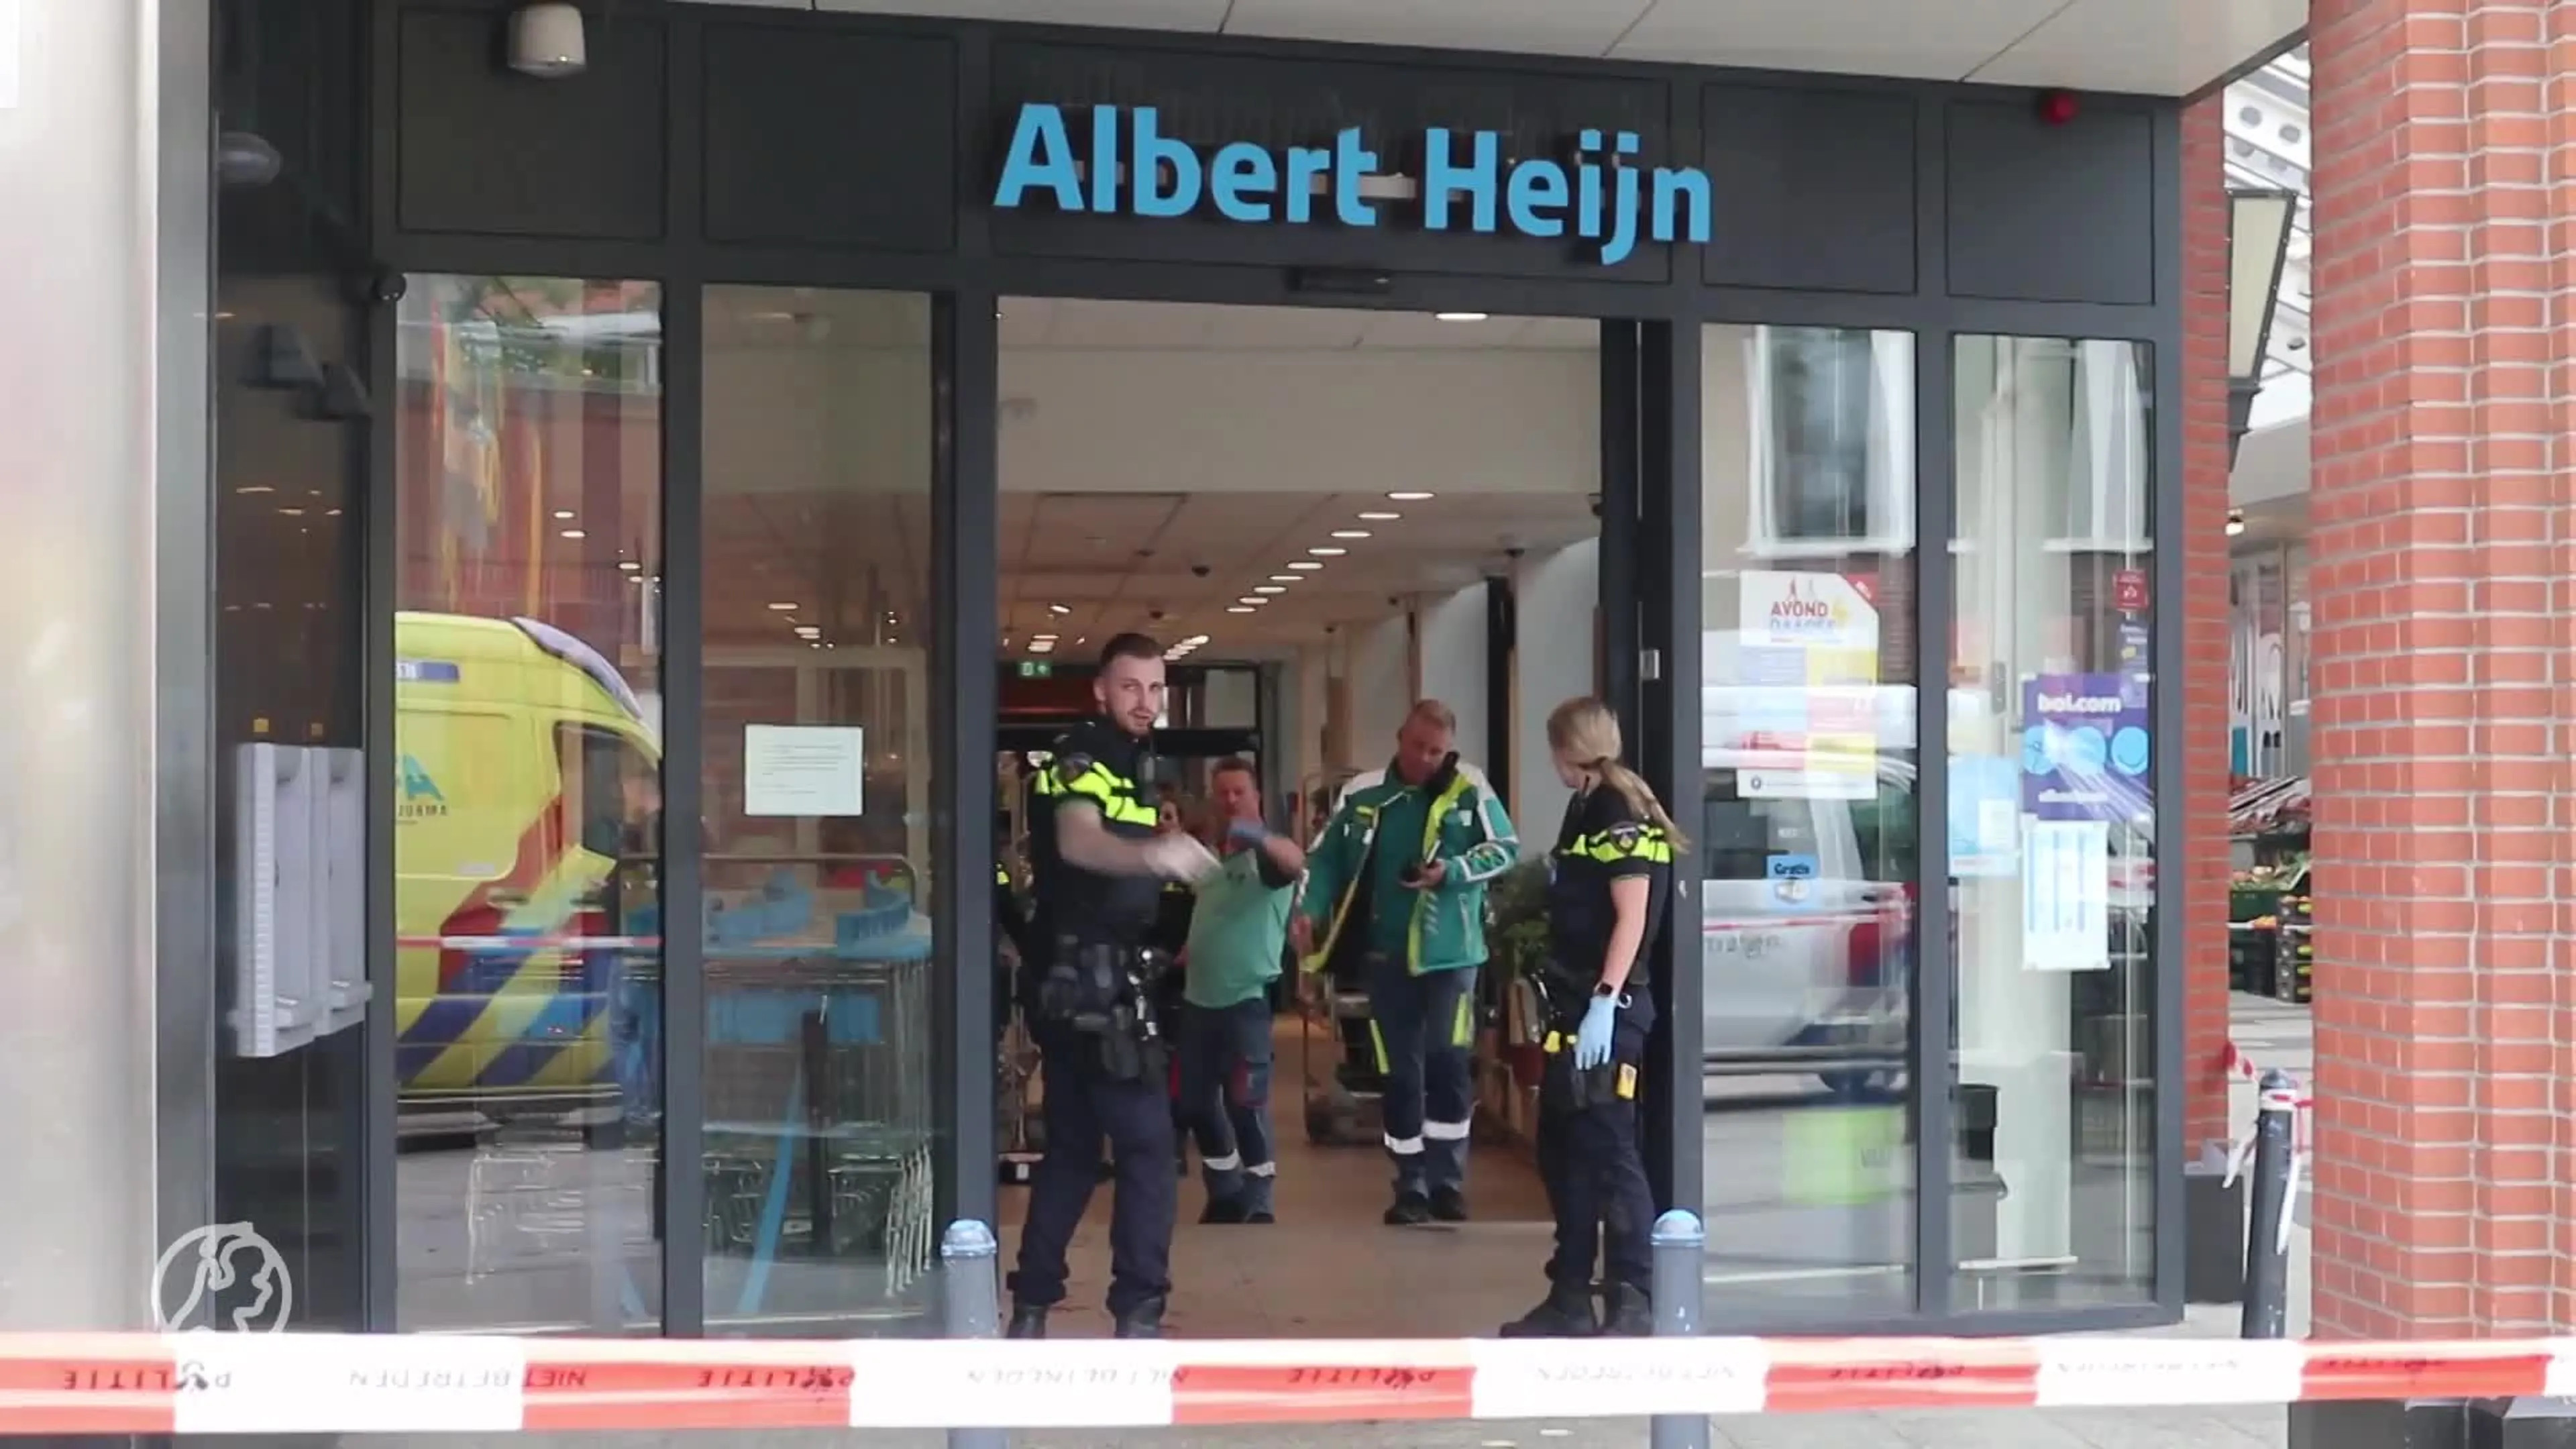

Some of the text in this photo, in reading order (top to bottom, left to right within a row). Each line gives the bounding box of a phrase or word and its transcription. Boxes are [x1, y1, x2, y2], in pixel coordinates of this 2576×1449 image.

[994, 103, 1710, 264] Albert Heijn
[1771, 601, 1829, 617] AVOND
